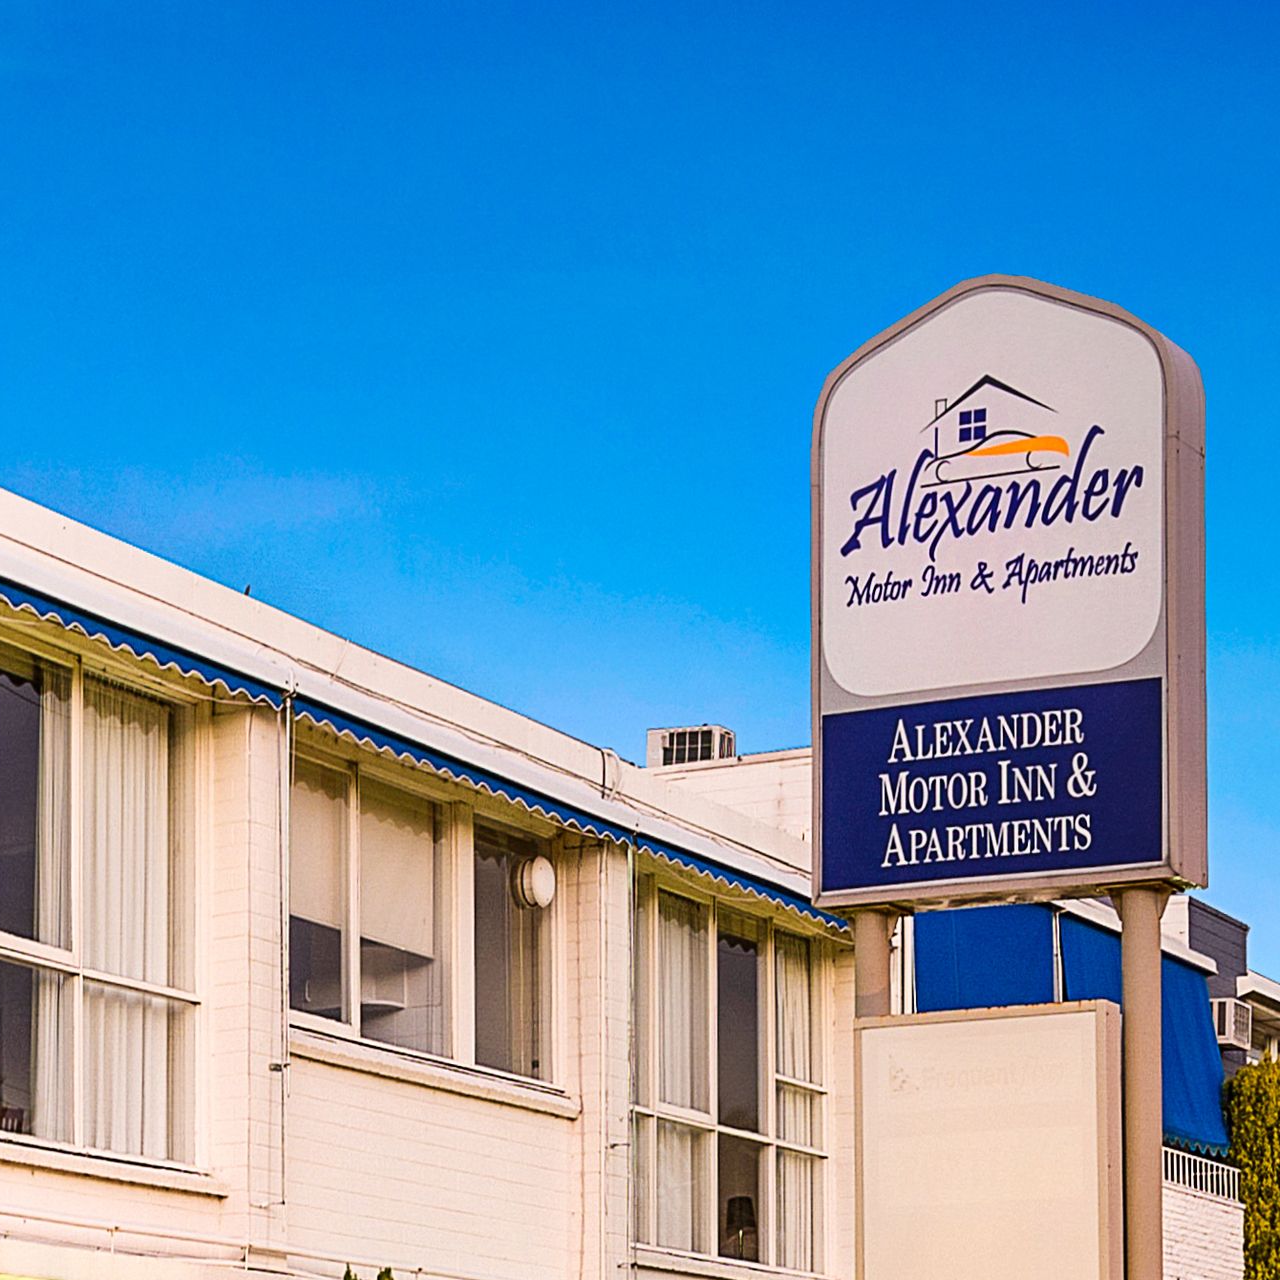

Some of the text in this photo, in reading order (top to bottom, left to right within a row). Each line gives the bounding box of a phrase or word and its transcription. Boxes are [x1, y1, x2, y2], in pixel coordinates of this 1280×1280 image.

[840, 424, 1144, 562] Alexander
[845, 542, 1139, 607] Motor Inn & Apartments
[887, 708, 1085, 763] ALEXANDER
[878, 752, 1097, 816] MOTOR INN &
[881, 813, 1092, 868] APARTMENTS
